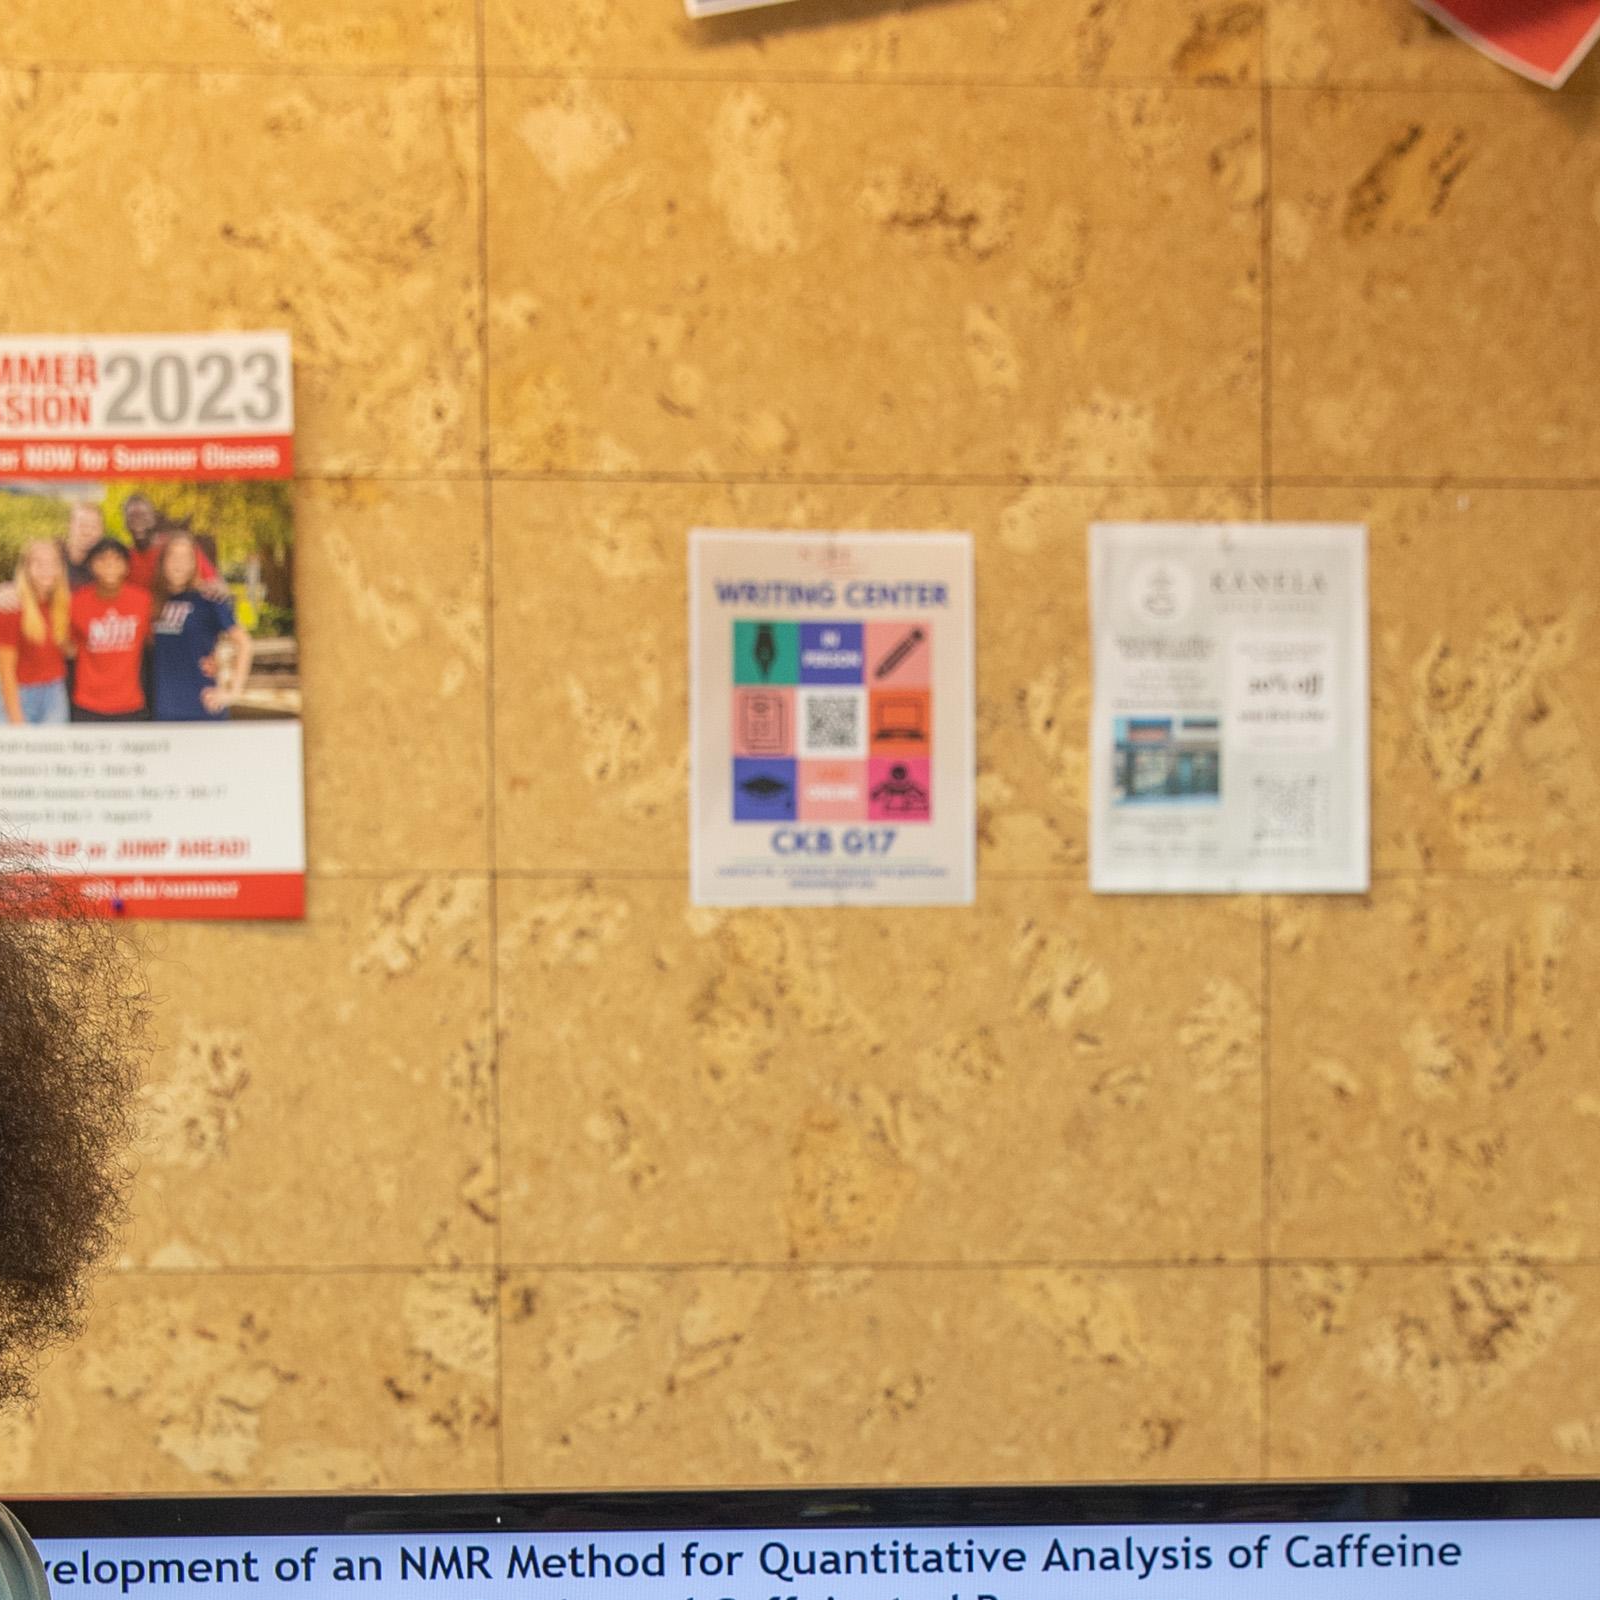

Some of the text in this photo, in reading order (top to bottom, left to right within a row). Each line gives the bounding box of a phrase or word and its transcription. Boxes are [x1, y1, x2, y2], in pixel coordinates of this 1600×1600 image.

[103, 350, 281, 427] 2023
[23, 445, 76, 471] NOW
[81, 444, 109, 471] for
[112, 444, 199, 471] Summer
[201, 443, 280, 470] Classes
[715, 579, 949, 608] WRITING CENTER
[115, 838, 171, 858] JUMP
[770, 828, 898, 855] CKB G17
[43, 1533, 1461, 1594] elopment of an NMR Method for Quantitative Analysis of Caffeine
